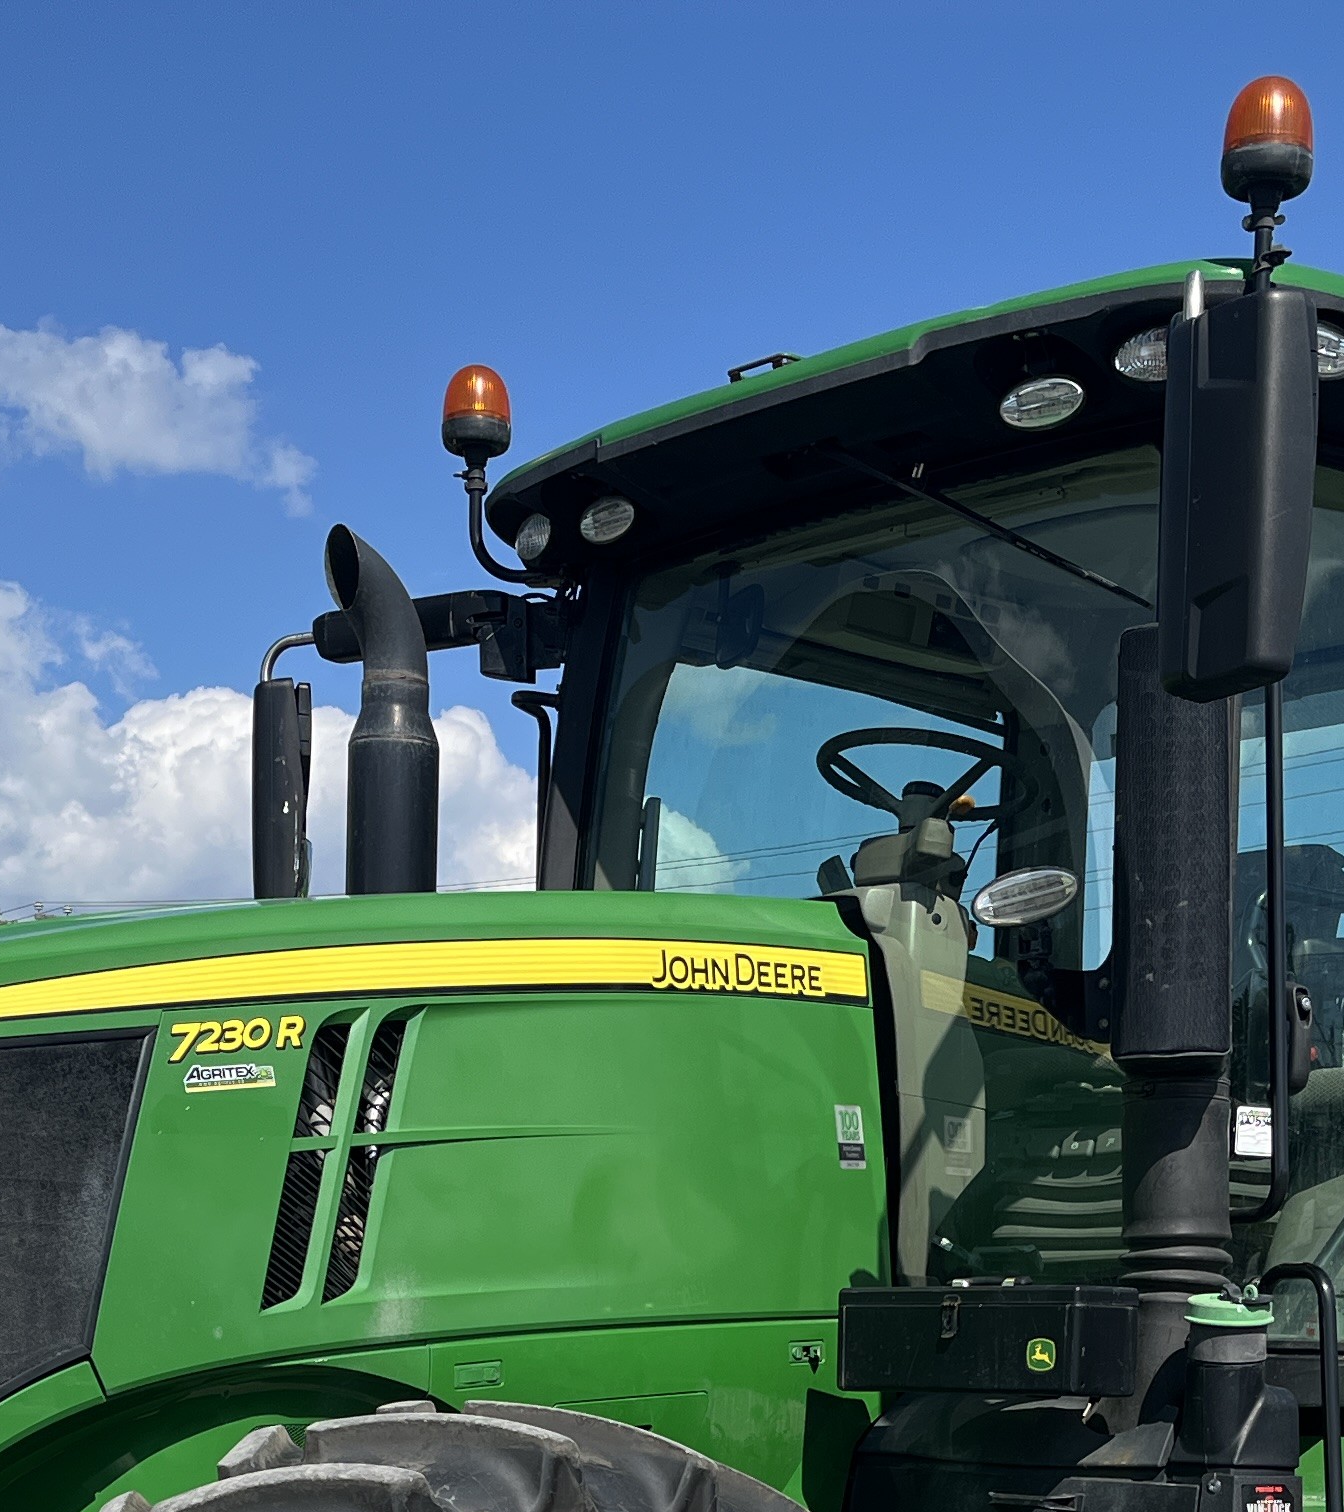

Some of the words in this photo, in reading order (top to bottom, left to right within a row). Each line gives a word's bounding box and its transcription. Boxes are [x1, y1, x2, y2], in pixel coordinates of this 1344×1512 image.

[652, 949, 729, 985] JOHN
[735, 953, 822, 991] DEERE
[168, 1017, 272, 1063] 7230
[275, 1014, 306, 1049] R
[186, 1065, 255, 1081] AGRITEX
[839, 1110, 859, 1130] 100
